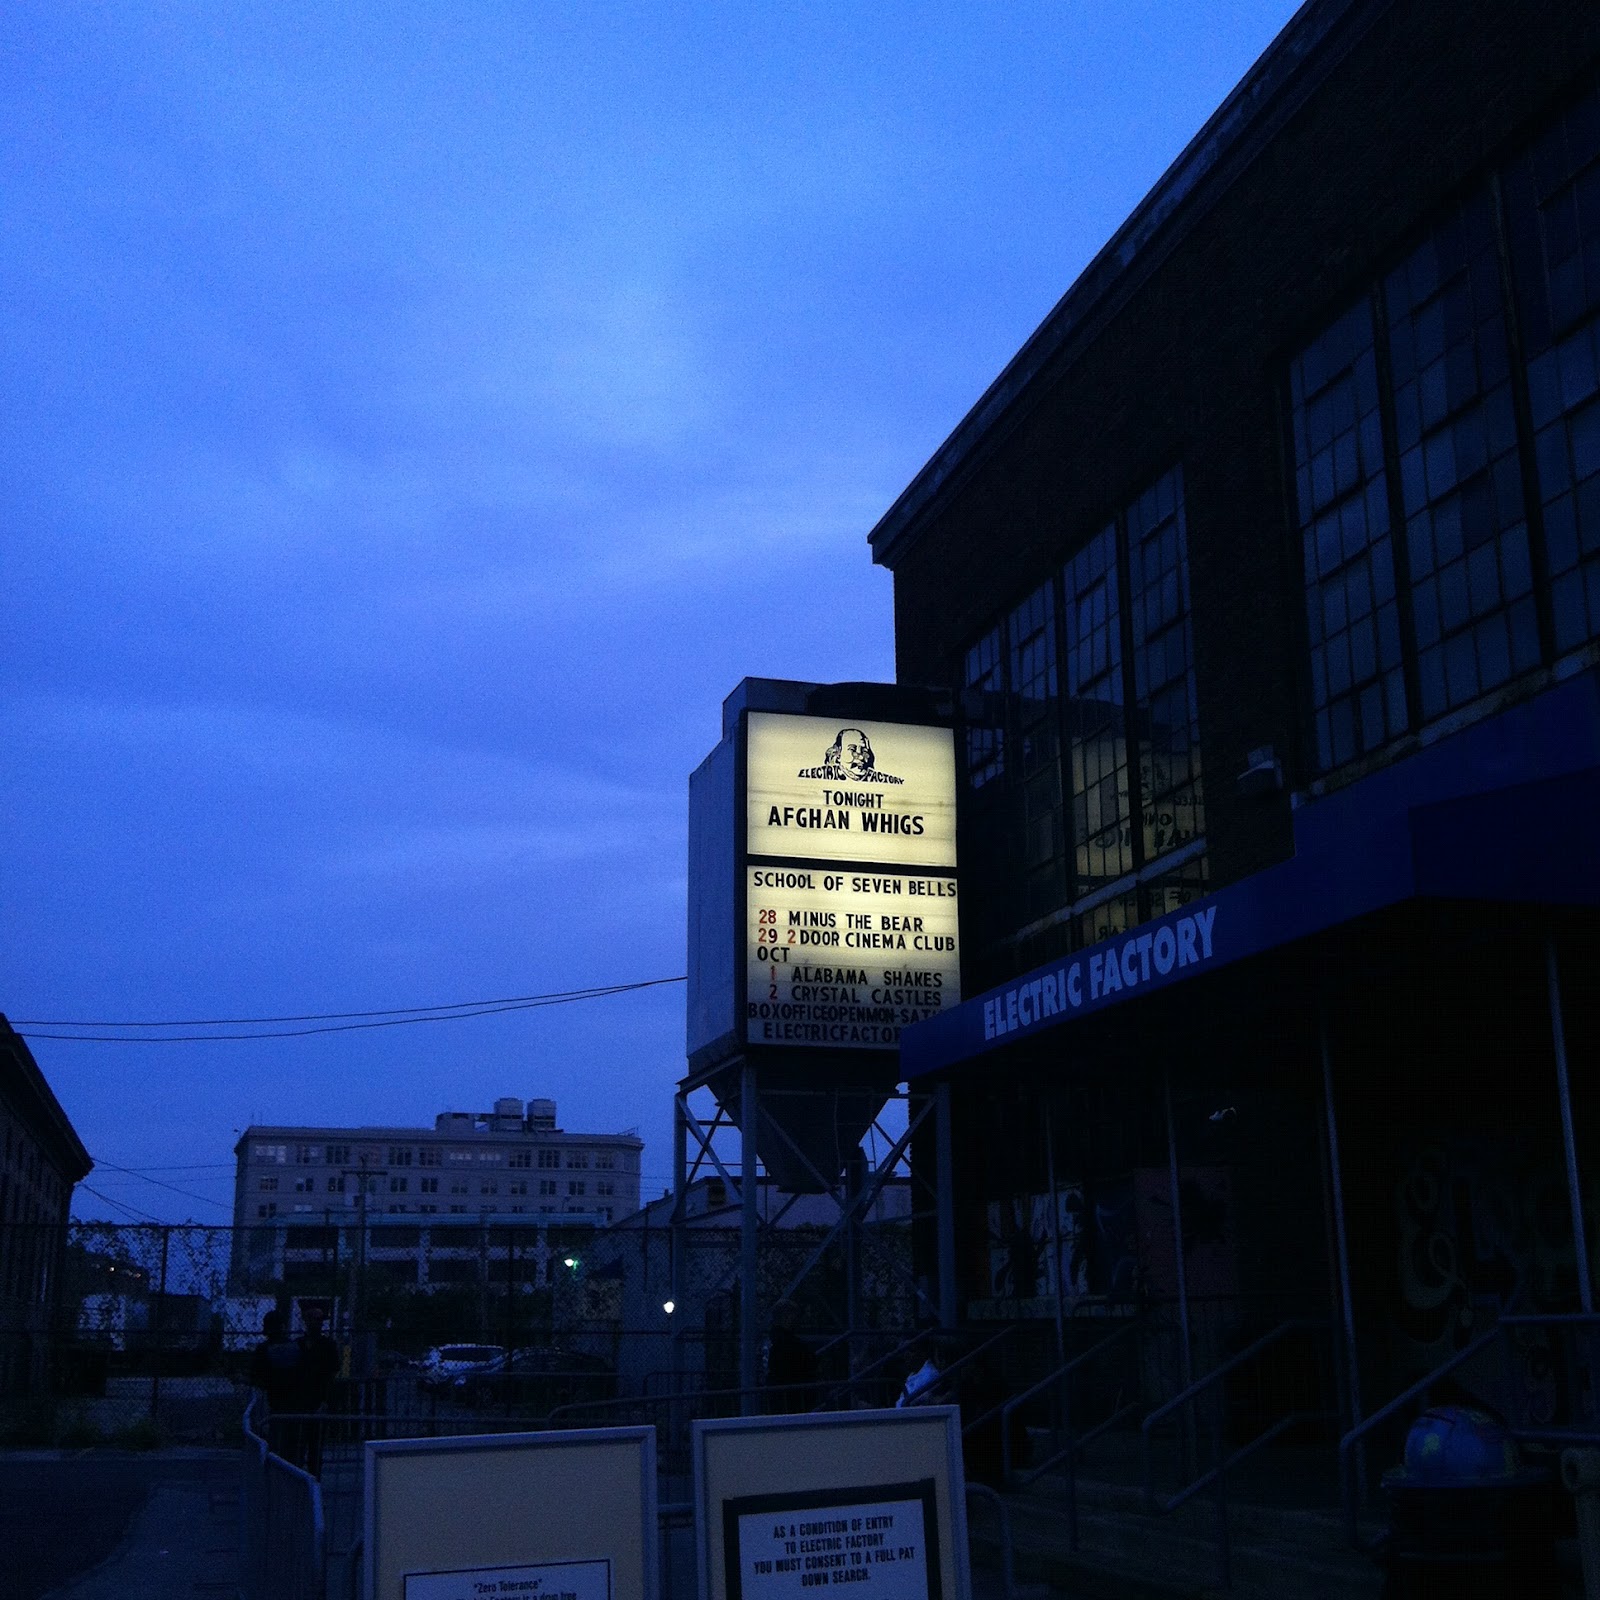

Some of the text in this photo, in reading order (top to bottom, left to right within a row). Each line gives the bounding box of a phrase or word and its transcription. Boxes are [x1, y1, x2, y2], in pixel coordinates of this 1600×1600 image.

[798, 765, 904, 785] ELECTRIC FACTORY
[823, 790, 884, 809] TONIGHT
[768, 806, 924, 835] AFGHAN WHIGS
[754, 871, 957, 897] SCHOOL OF SEVEN BELLS
[758, 909, 923, 932] 28 MINUS THE BEAR
[758, 928, 778, 943] 29
[845, 932, 906, 949] CINEMA
[914, 935, 955, 951] CLUB
[757, 946, 790, 962] OCT
[770, 965, 943, 988] 1 ALABAMA SHAKES
[984, 905, 1217, 1041] ELECTRIC FACTORY
[769, 985, 941, 1007] 2 CRYSTAL CASTLES
[774, 1516, 893, 1539] AS A CONDITION OF ENTRY
[785, 1533, 884, 1554] TO ELECTRIC FACTORY
[754, 1546, 915, 1574] YOU MUST CONSENT TO A FULL PAT
[802, 1573, 829, 1587] DOWN
